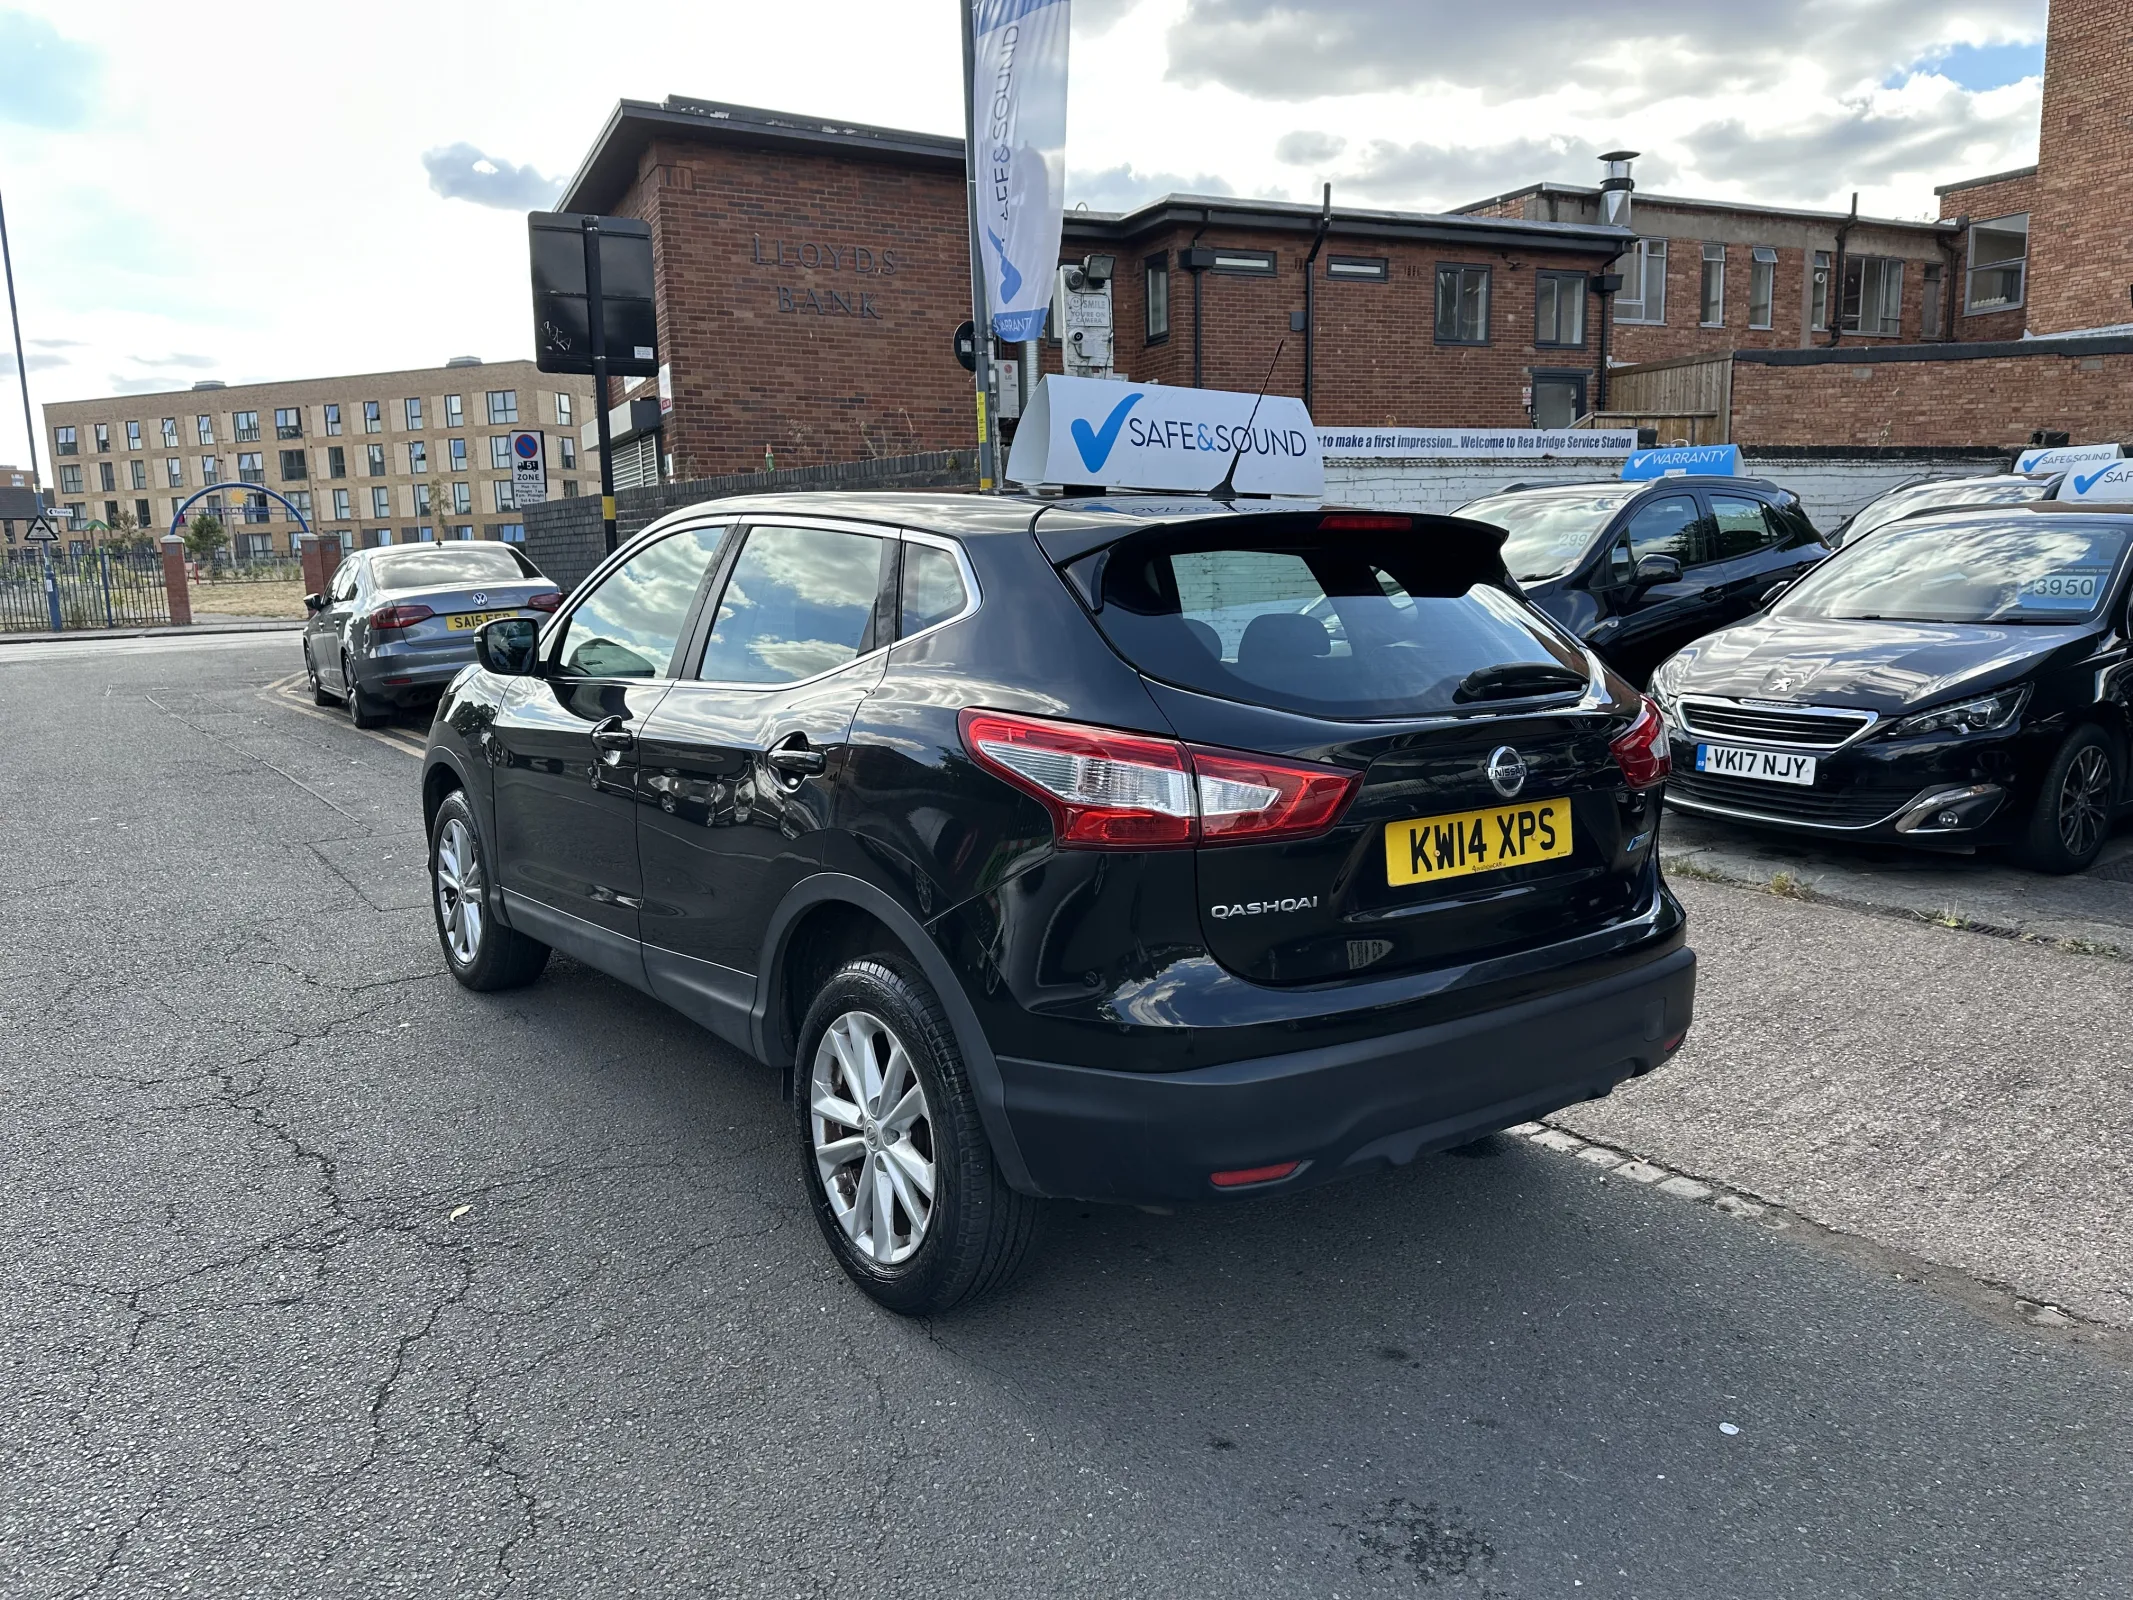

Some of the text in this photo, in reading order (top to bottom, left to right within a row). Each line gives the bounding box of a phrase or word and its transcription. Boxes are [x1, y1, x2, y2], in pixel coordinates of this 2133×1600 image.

[754, 235, 897, 276] LLOYDS
[778, 286, 883, 320] BANK
[1083, 299, 1106, 309] SMILE
[1129, 417, 1307, 457] SAFE&SOUND
[1323, 435, 1334, 447] to
[1335, 435, 1364, 447] make
[1366, 437, 1372, 447] a
[1374, 435, 1396, 447] first
[1460, 436, 1504, 448] Welcome
[1506, 437, 1515, 448] to
[1517, 436, 1534, 448] Rea
[1536, 436, 1566, 449] Bridge
[1567, 436, 1600, 448] Service
[1601, 436, 1632, 448] Station
[1652, 450, 1730, 465] WARRANTY
[2034, 579, 2094, 596] 3950
[454, 615, 483, 628] SA15
[1714, 749, 1806, 778] VK17 NJY
[1410, 808, 1556, 874] KW14 XPS
[1211, 895, 1319, 920] QASHQAI
